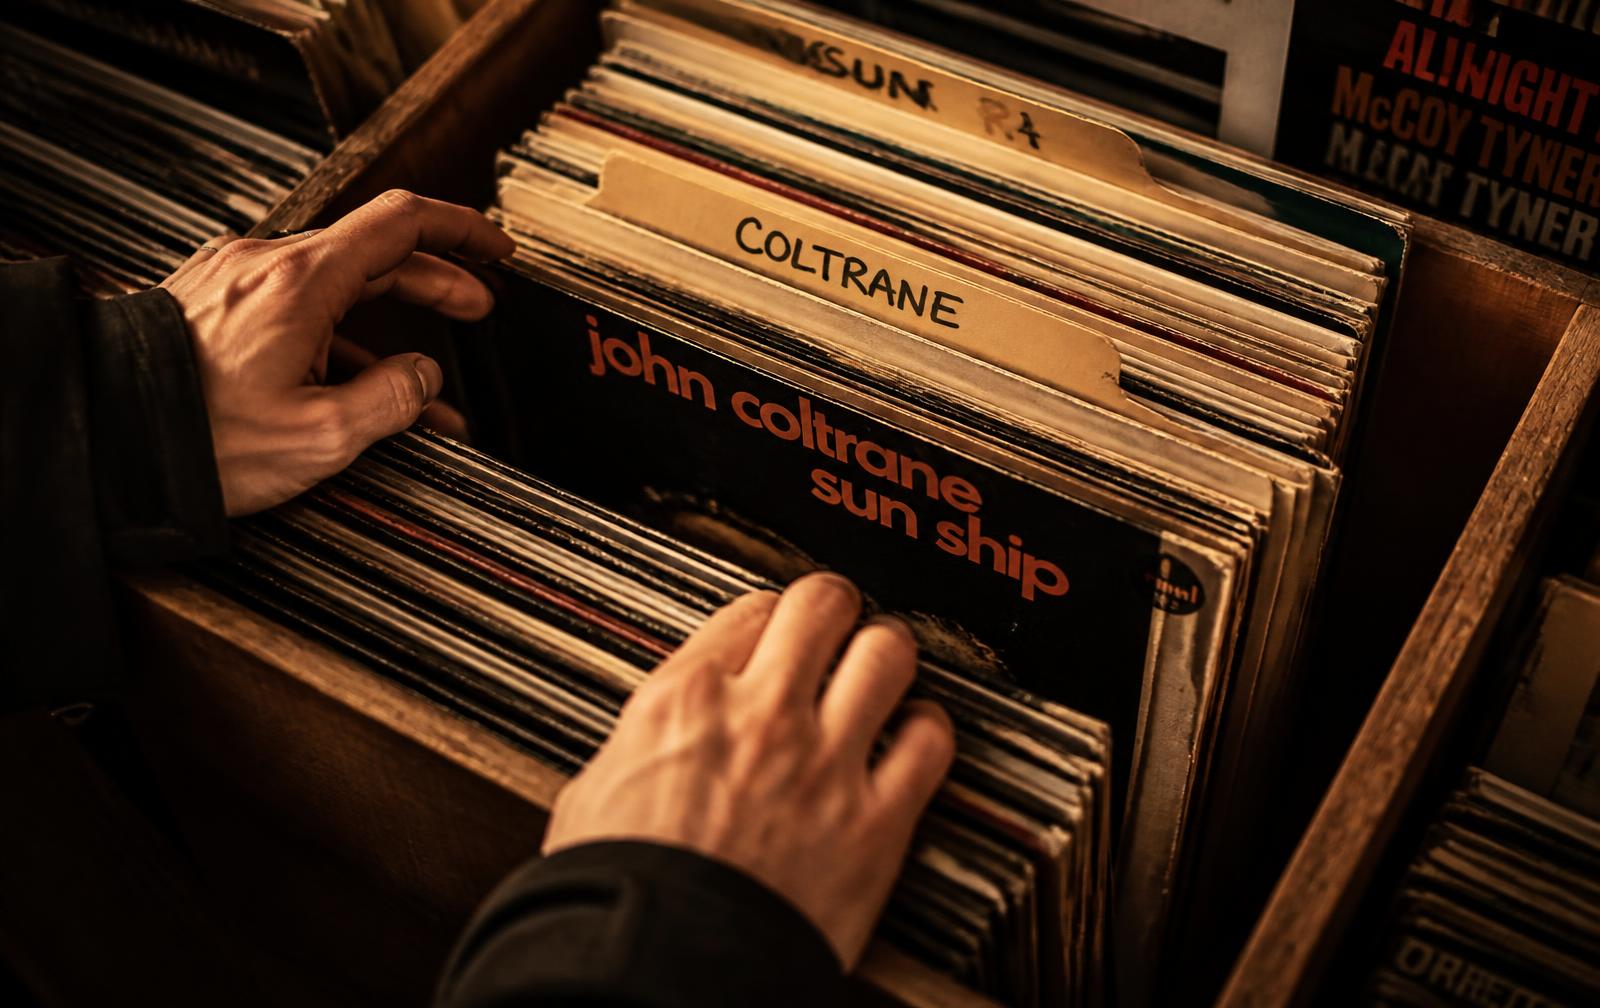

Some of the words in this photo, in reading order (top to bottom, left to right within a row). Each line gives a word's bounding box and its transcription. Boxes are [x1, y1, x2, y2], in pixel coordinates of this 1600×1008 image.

[1331, 64, 1473, 157] McCOY
[1476, 114, 1600, 208] TYNER
[735, 217, 965, 329] COLTRANE
[1458, 170, 1600, 263] TYNER
[585, 314, 717, 411] john
[731, 390, 983, 513] coltrane
[810, 468, 919, 539] sun
[935, 512, 1070, 601] ship
